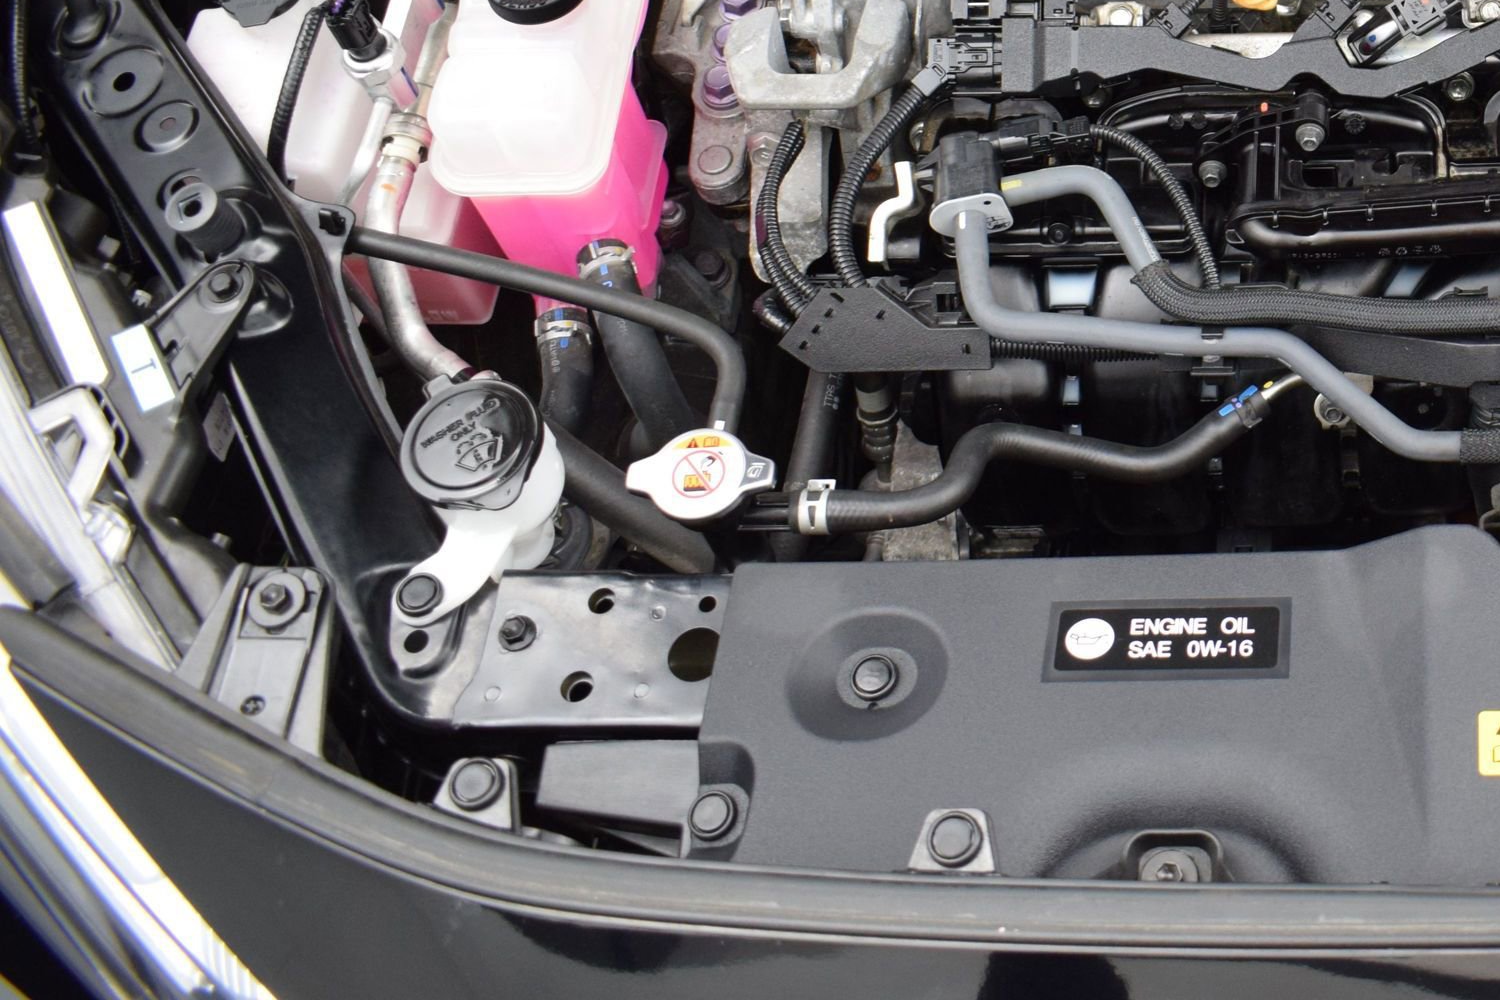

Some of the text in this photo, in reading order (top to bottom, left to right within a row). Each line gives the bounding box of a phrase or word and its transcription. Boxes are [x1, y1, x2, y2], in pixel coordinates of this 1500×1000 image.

[420, 418, 464, 448] WASHER
[450, 421, 476, 442] ONLY
[1129, 617, 1256, 636] ENGINE OIL
[1127, 639, 1254, 660] SAE 0W-16
